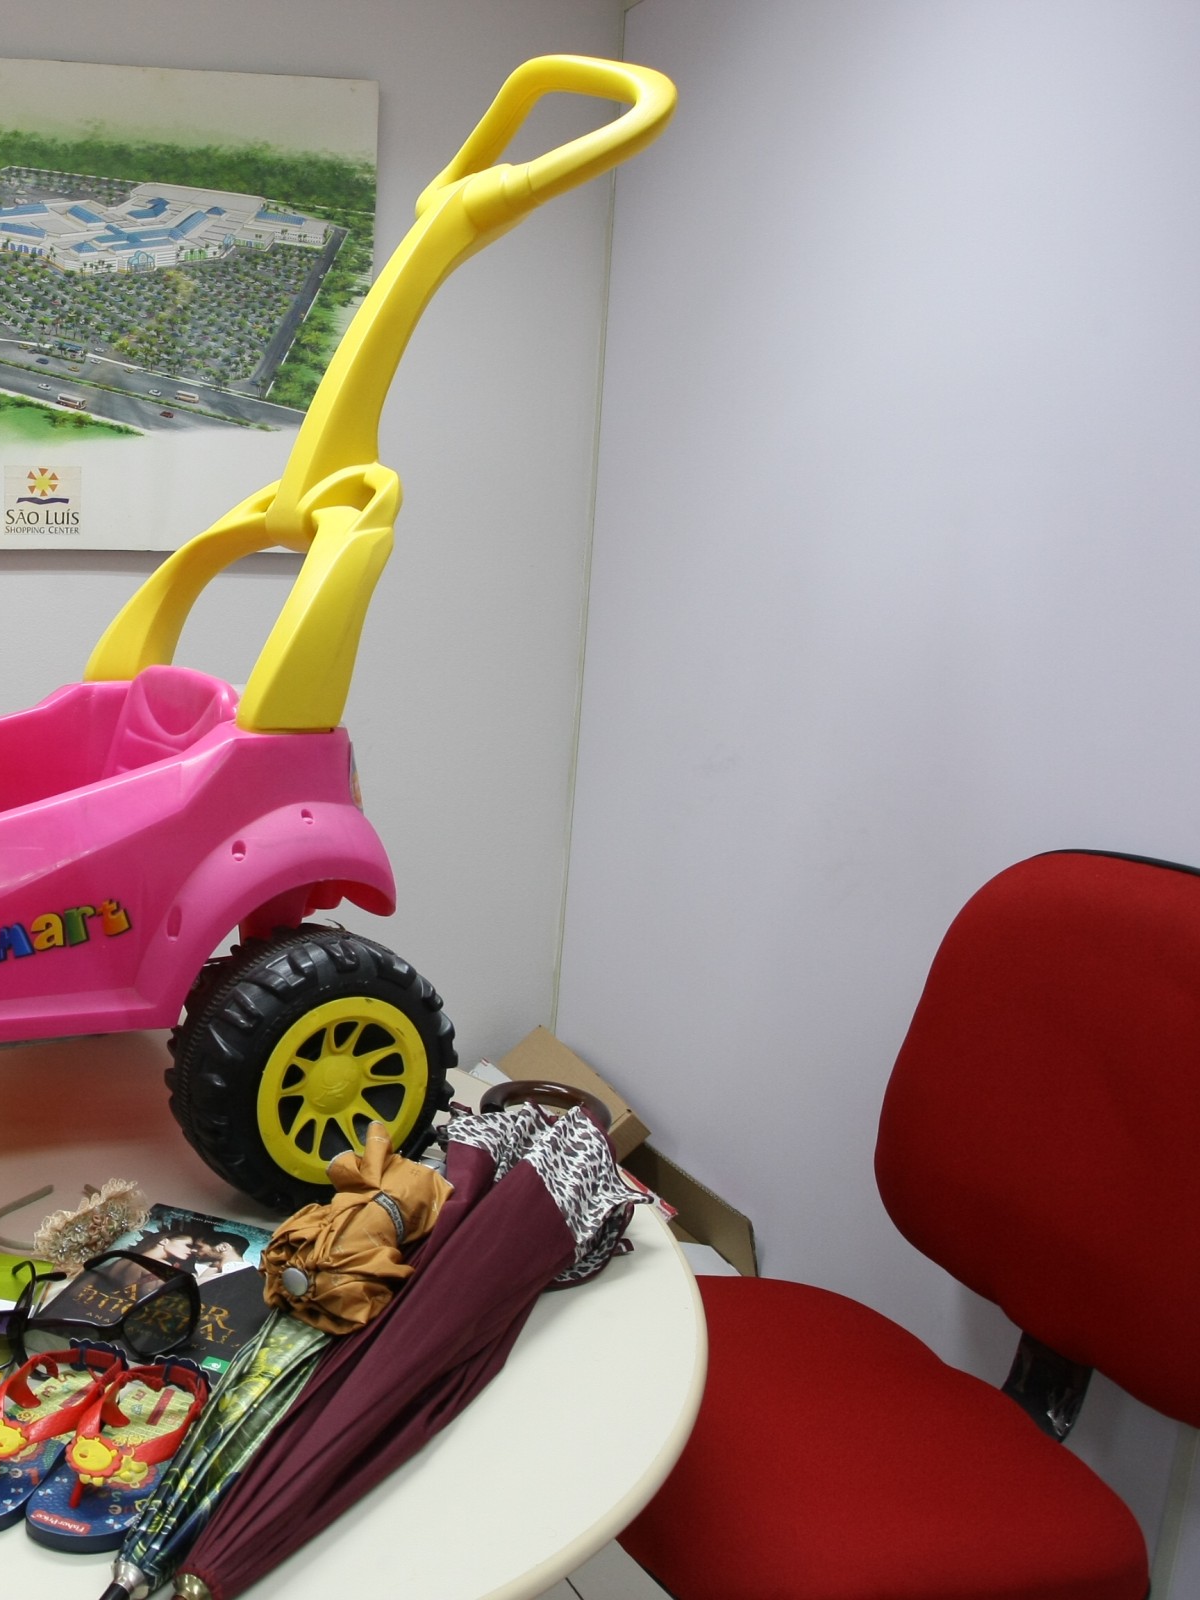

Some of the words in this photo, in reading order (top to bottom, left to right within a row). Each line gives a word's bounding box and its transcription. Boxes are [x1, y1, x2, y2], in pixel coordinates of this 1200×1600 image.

[5, 509, 39, 525] SÃO
[5, 526, 45, 534] SHOPPING
[48, 526, 79, 534] CENTER
